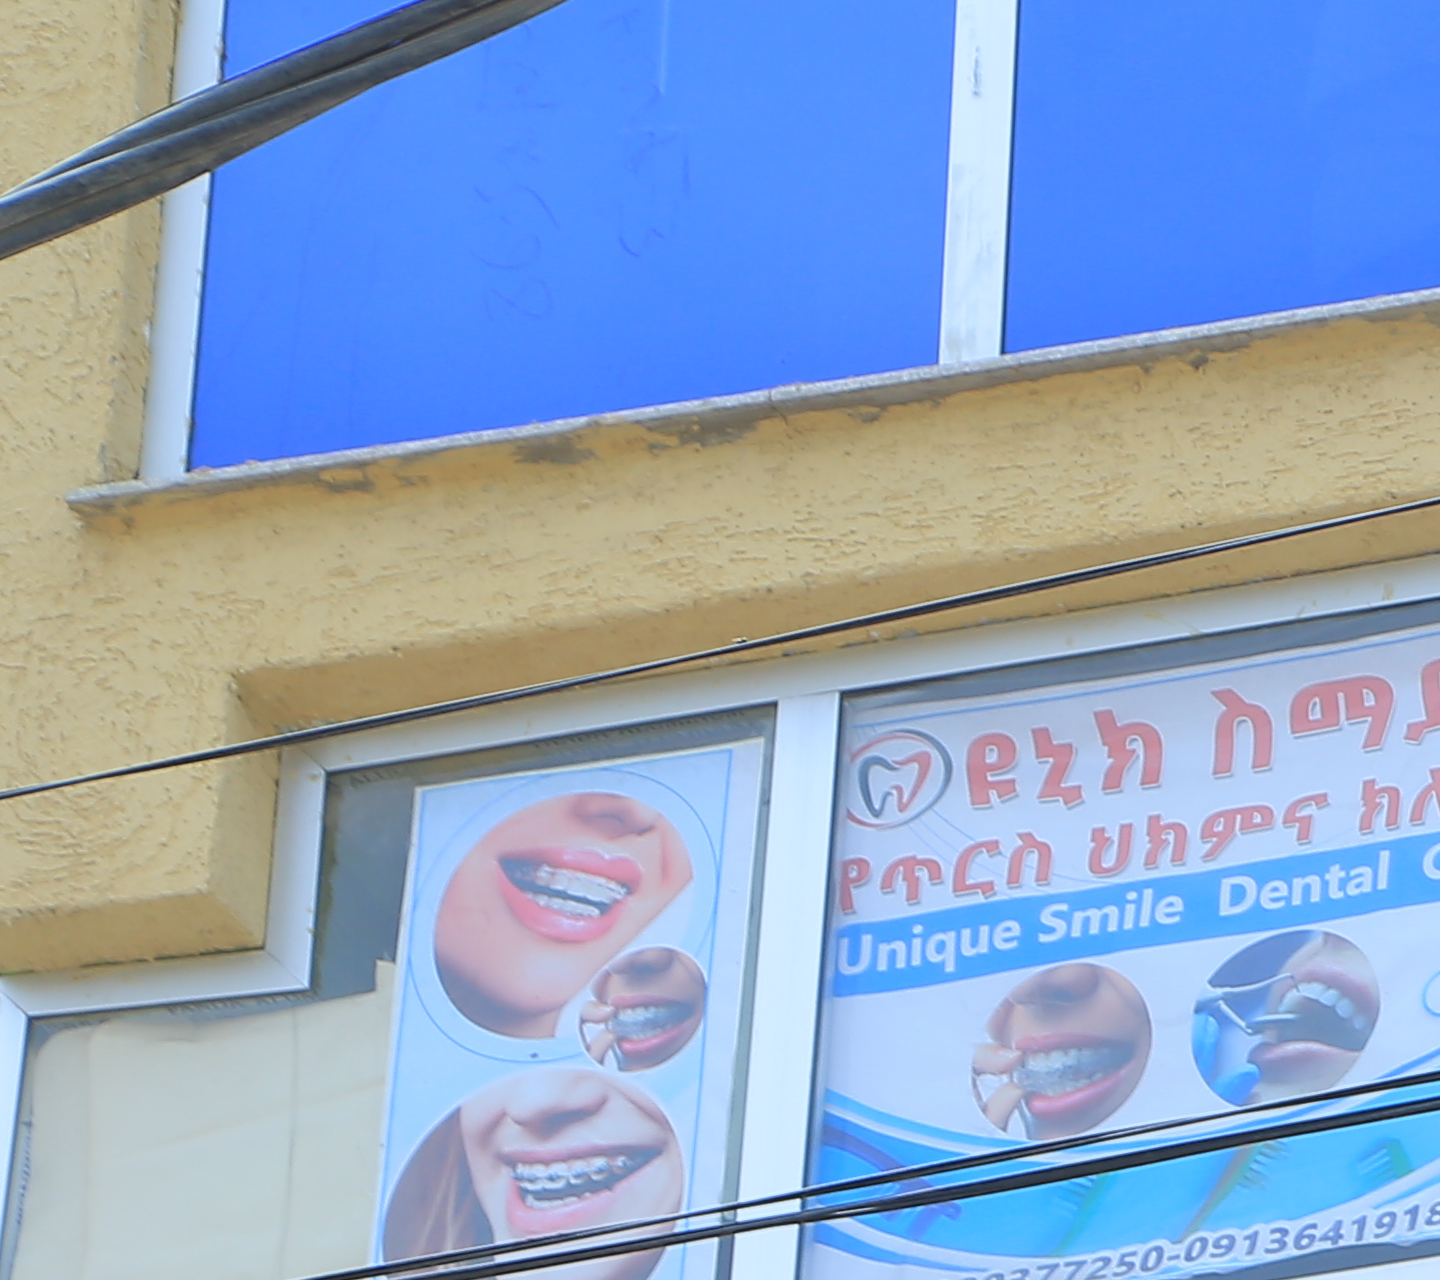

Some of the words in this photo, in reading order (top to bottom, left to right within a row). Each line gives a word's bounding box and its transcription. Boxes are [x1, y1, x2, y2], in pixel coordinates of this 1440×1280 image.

[964, 708, 1164, 809] ዩኒክ
[837, 832, 1053, 915] የጥርስ
[1087, 791, 1330, 878] ህክምና
[837, 921, 1020, 977] Unique
[1037, 888, 1185, 944] Smile
[1218, 851, 1391, 917] Dental
